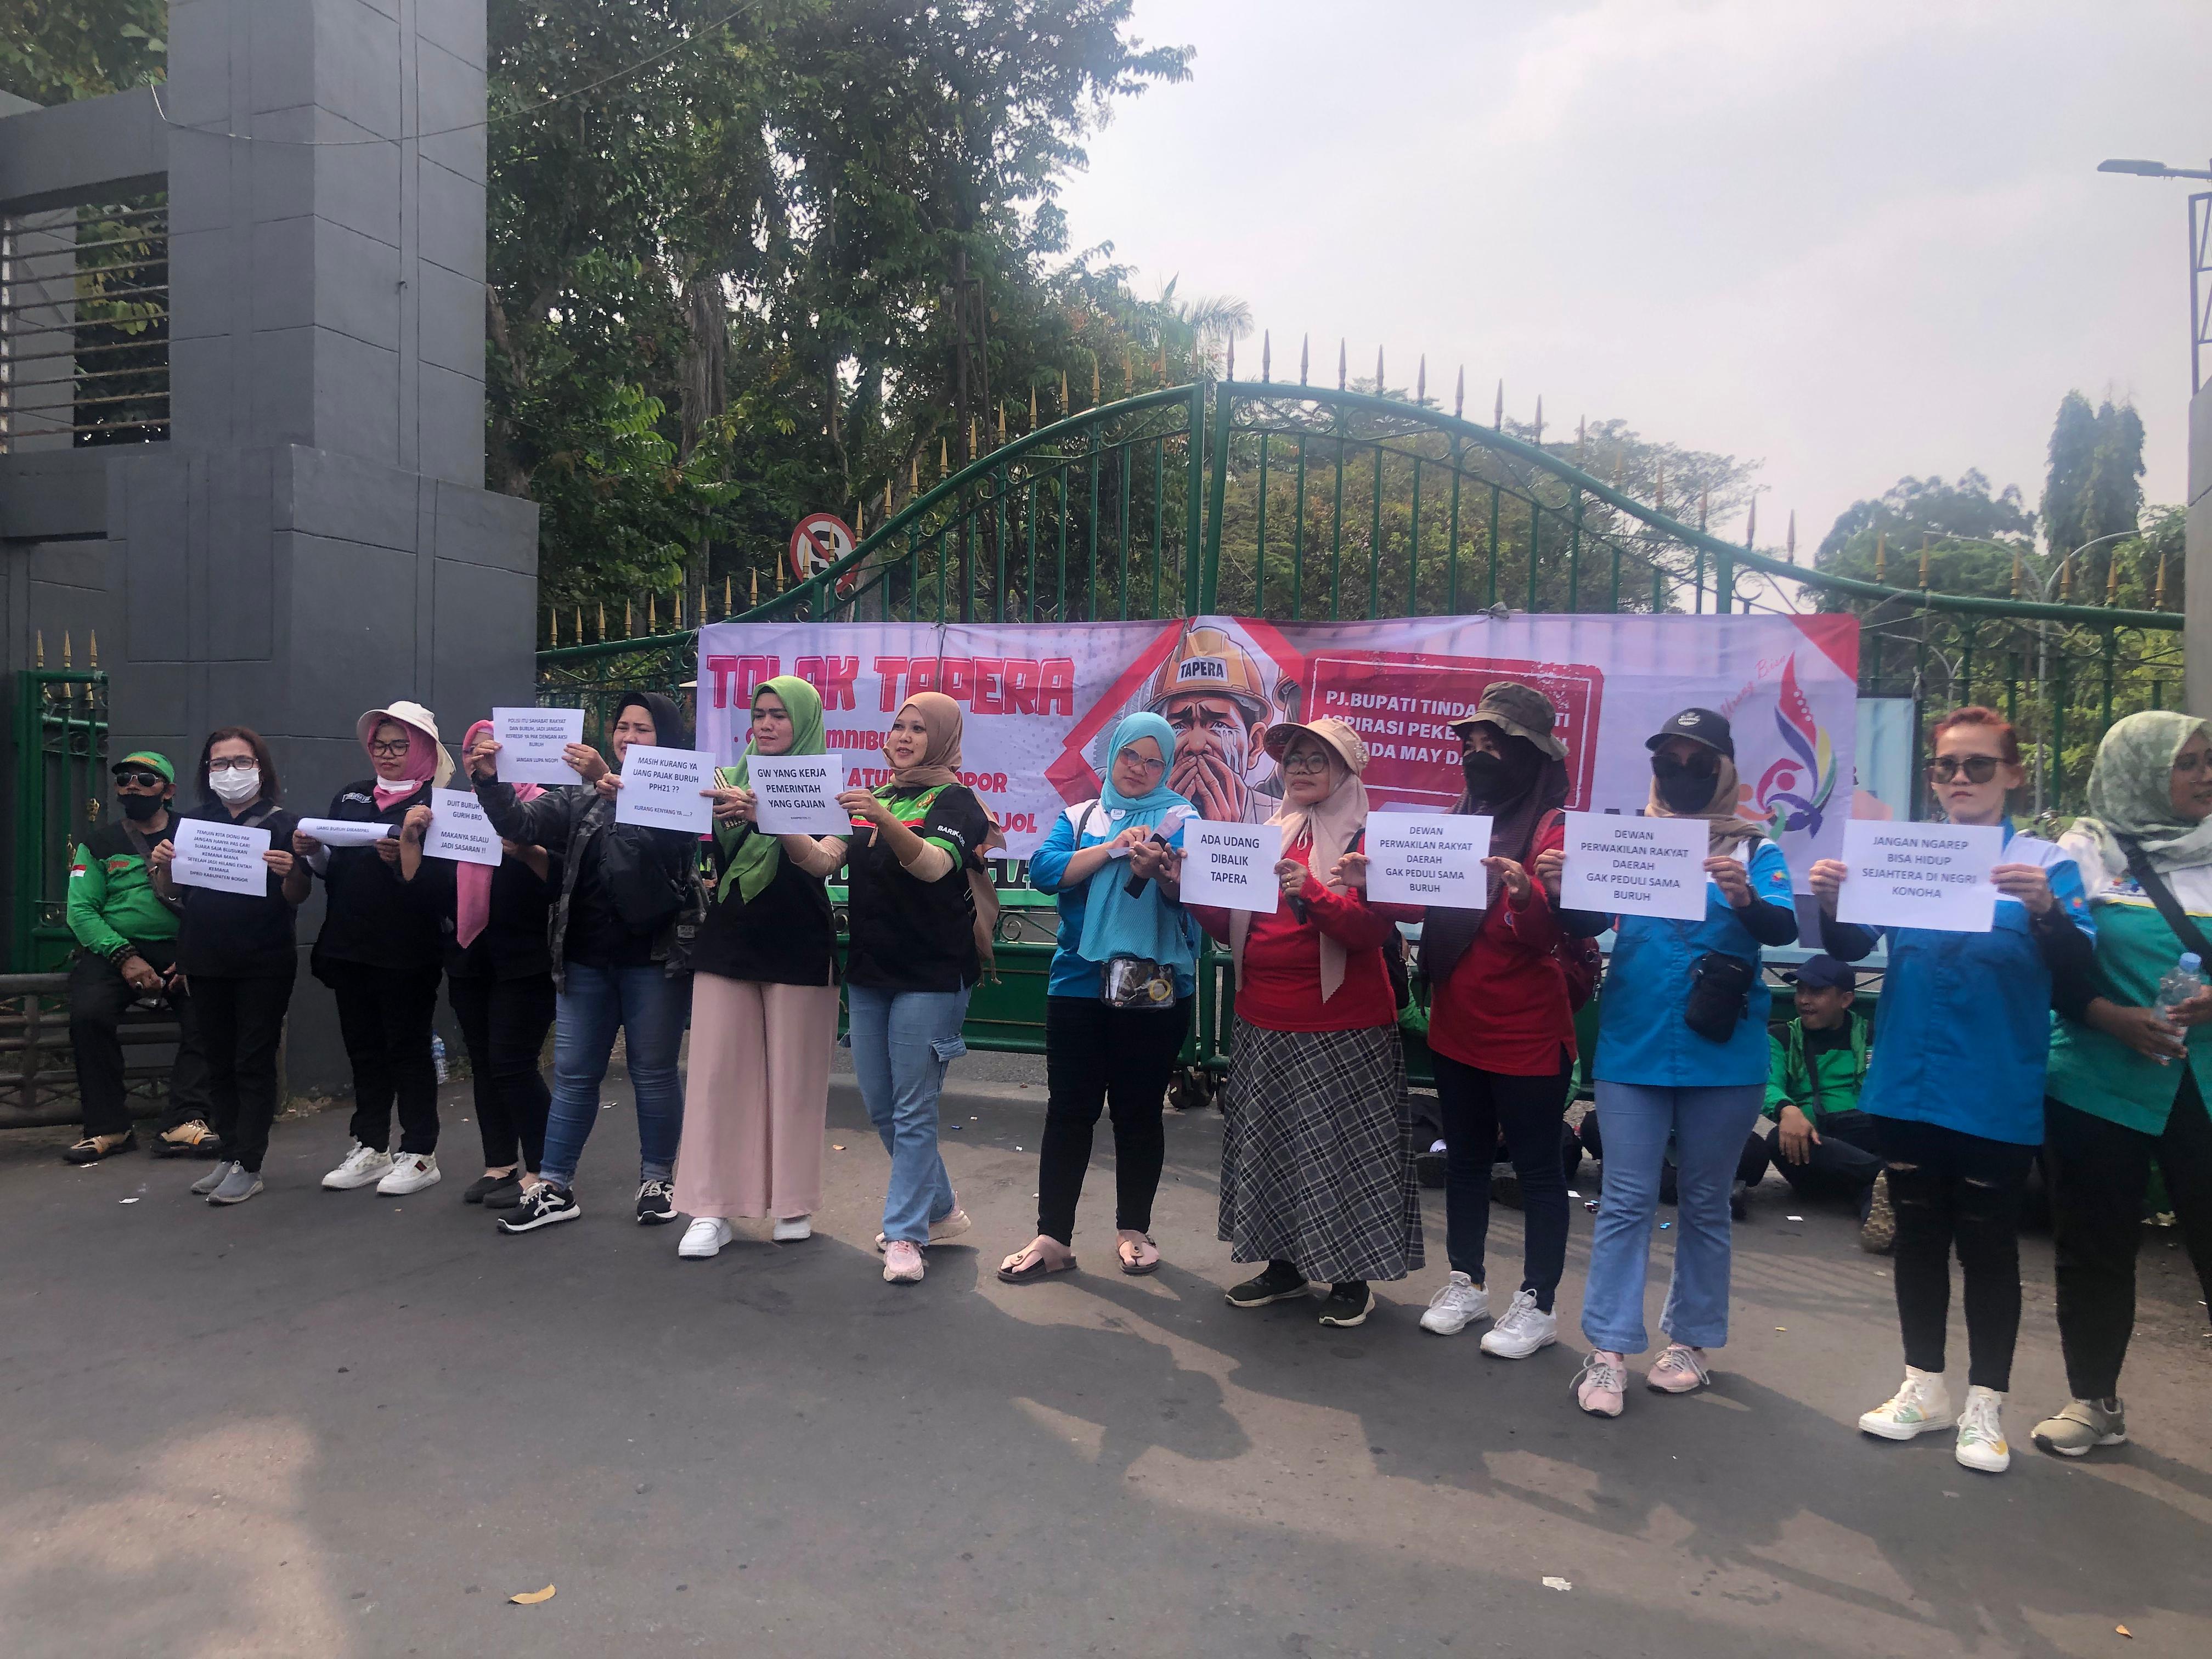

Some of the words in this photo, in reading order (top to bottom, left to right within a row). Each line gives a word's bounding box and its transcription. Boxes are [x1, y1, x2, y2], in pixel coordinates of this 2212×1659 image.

[1181, 662, 1223, 678] TAPERA
[873, 656, 1075, 715] TAPERA
[1325, 690, 1417, 712] PJ.BUPATI
[1420, 699, 1476, 717] TINDA
[1400, 746, 1442, 763] MAY
[637, 757, 658, 765] MASIH
[659, 759, 687, 769] KURANG
[633, 769, 652, 777] UANG
[653, 771, 673, 780] PAJAK
[675, 774, 699, 783] BURUH
[758, 769, 771, 777] GW
[774, 769, 797, 777] YANG
[799, 768, 826, 777] KERJA
[650, 783, 670, 792] PPH21
[766, 785, 821, 793] PEMERINTAH
[461, 802, 479, 810] BURUH
[1409, 827, 1443, 835] DEWAN
[1615, 830, 1654, 840] DEWAN
[441, 831, 469, 842] MAKANYA
[470, 834, 489, 843] SELALU
[1201, 834, 1220, 845] ADA
[1223, 836, 1260, 848] UDANG
[455, 844, 479, 853] SASARAN
[1380, 840, 1436, 849] PERWAKILAN
[1438, 842, 1472, 850] RAKYAT
[1873, 837, 1918, 848] JANGAN
[1921, 839, 1968, 850] NGAREP
[1581, 842, 1646, 855] PERWAKILAN
[1650, 847, 1689, 857] RAKYAT
[1211, 853, 1248, 866] DIBALIK
[1407, 855, 1442, 864] DAERAH
[1887, 854, 1912, 864] BISA
[1915, 855, 1951, 865] HIDUP
[1612, 860, 1655, 871] DAERAH
[1211, 871, 1247, 884] TAPERA
[1406, 870, 1435, 878] PEDULI
[1438, 871, 1464, 879] SAMA
[1862, 868, 1922, 881] SEJAHTERA
[1926, 873, 1937, 881] DI
[1941, 873, 1977, 884] NEGRI
[1587, 873, 1607, 882] GAK
[1611, 874, 1646, 885] PEDULI
[1649, 878, 1680, 888] SAMA
[1409, 883, 1440, 892] BURUH
[1892, 887, 1942, 898] KONOHA
[1613, 890, 1651, 901] BURUH
